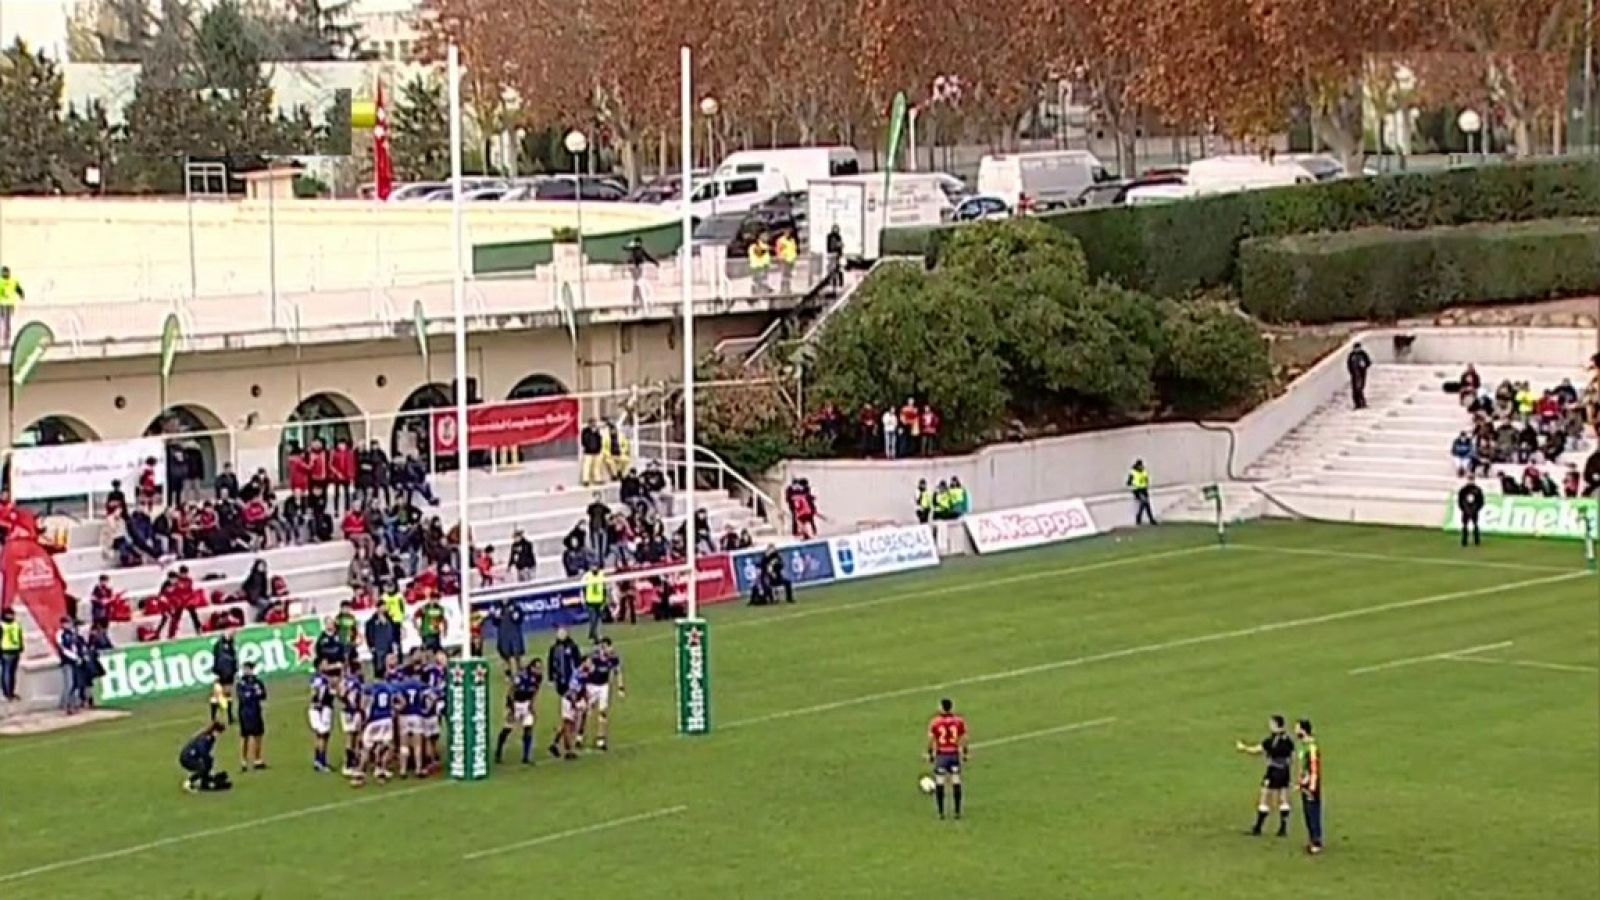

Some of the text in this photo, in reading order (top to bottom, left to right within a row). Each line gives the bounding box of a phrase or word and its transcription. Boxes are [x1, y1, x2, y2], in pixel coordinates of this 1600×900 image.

[100, 629, 290, 700] Heineen
[407, 688, 417, 704] 7
[938, 724, 958, 744] 23
